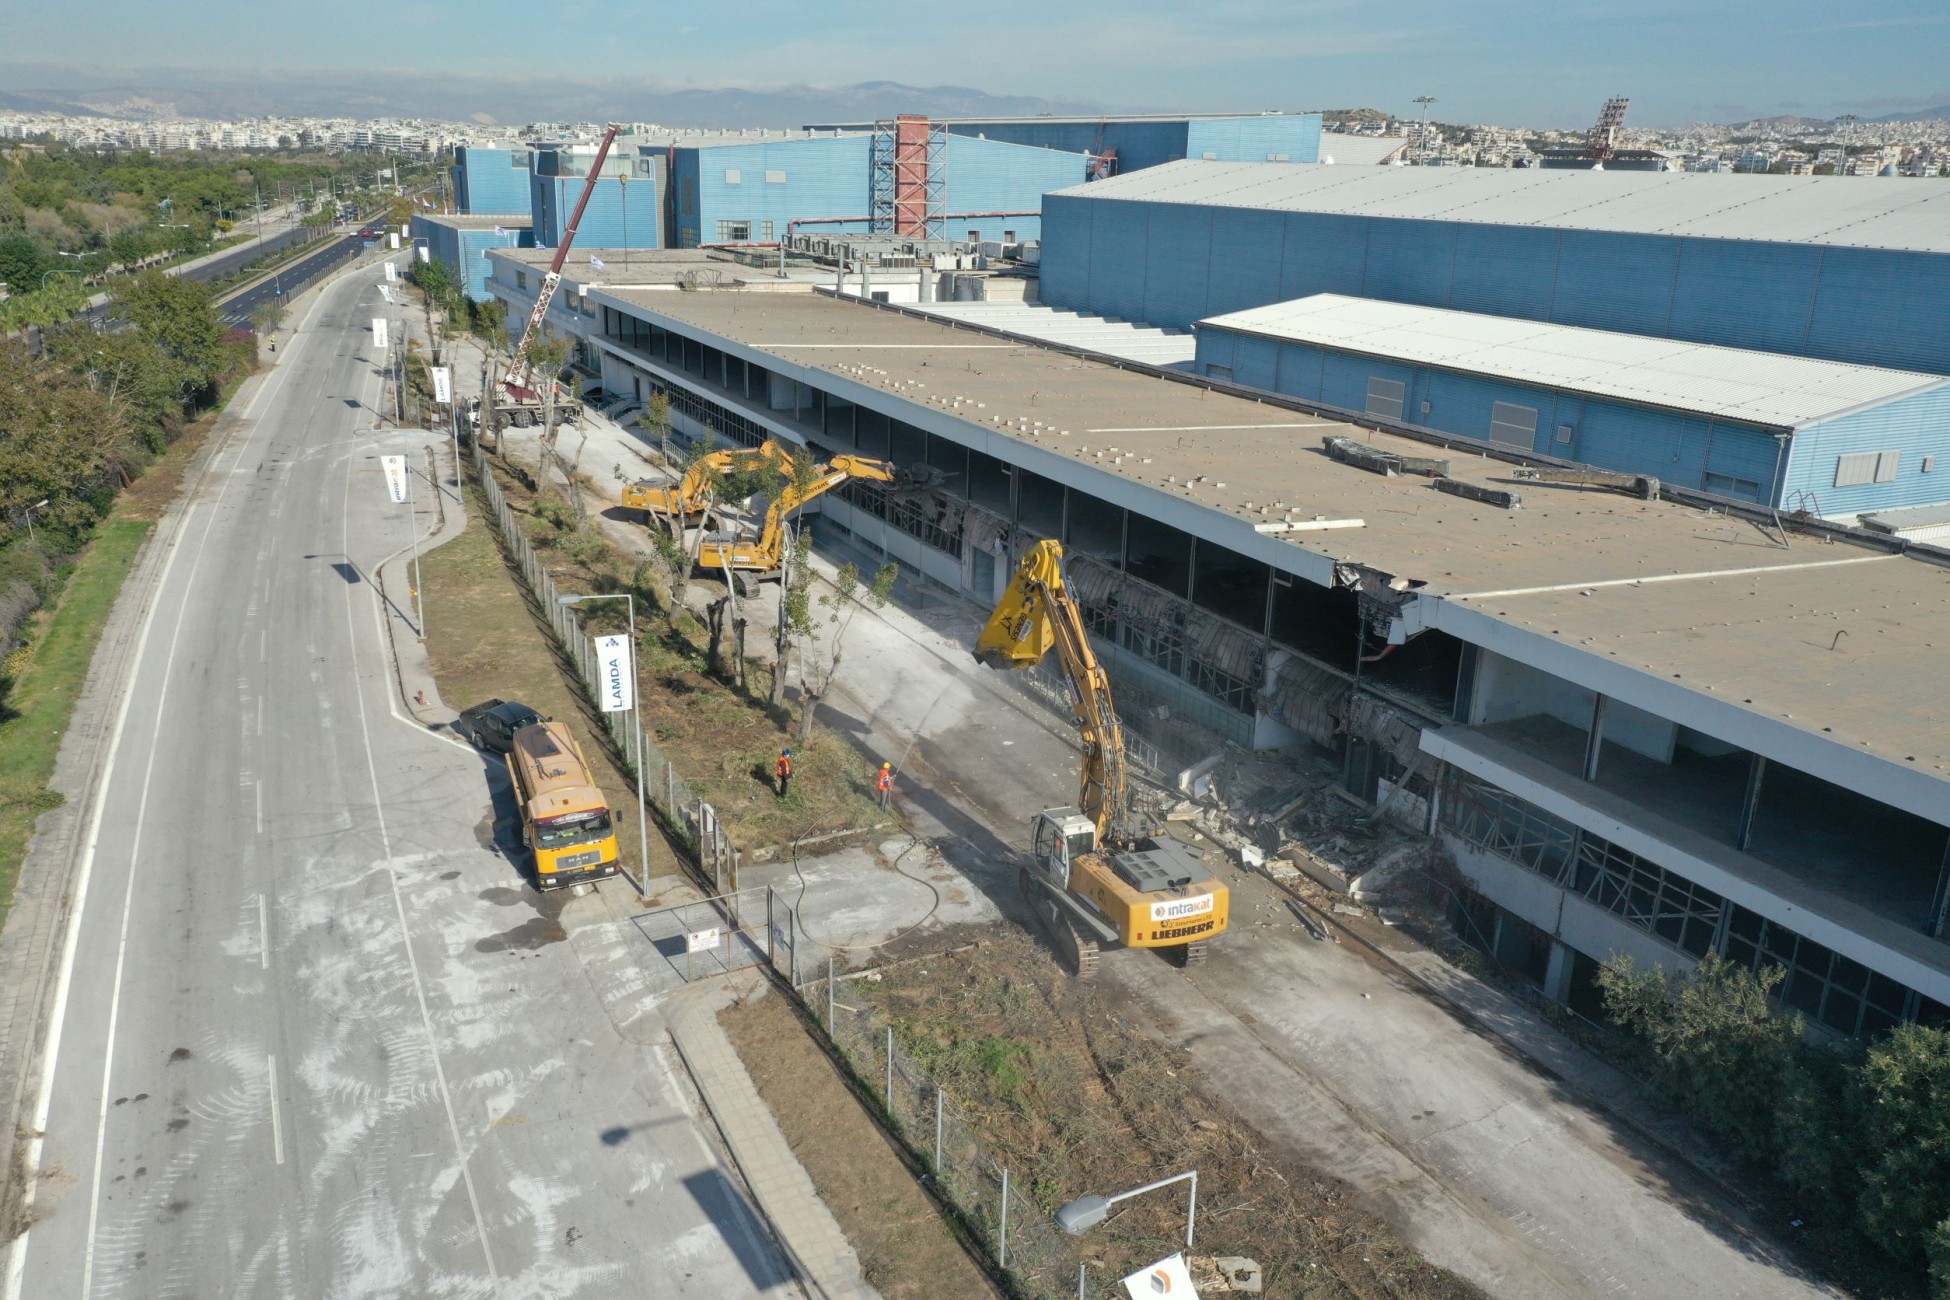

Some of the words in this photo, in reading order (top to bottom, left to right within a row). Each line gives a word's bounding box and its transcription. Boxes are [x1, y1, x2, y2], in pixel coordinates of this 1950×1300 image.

[1010, 612, 1027, 642] GENESIS
[609, 658, 623, 708] LAMDA
[1168, 898, 1211, 917] intrakat
[1151, 920, 1215, 940] LIEBHERR
